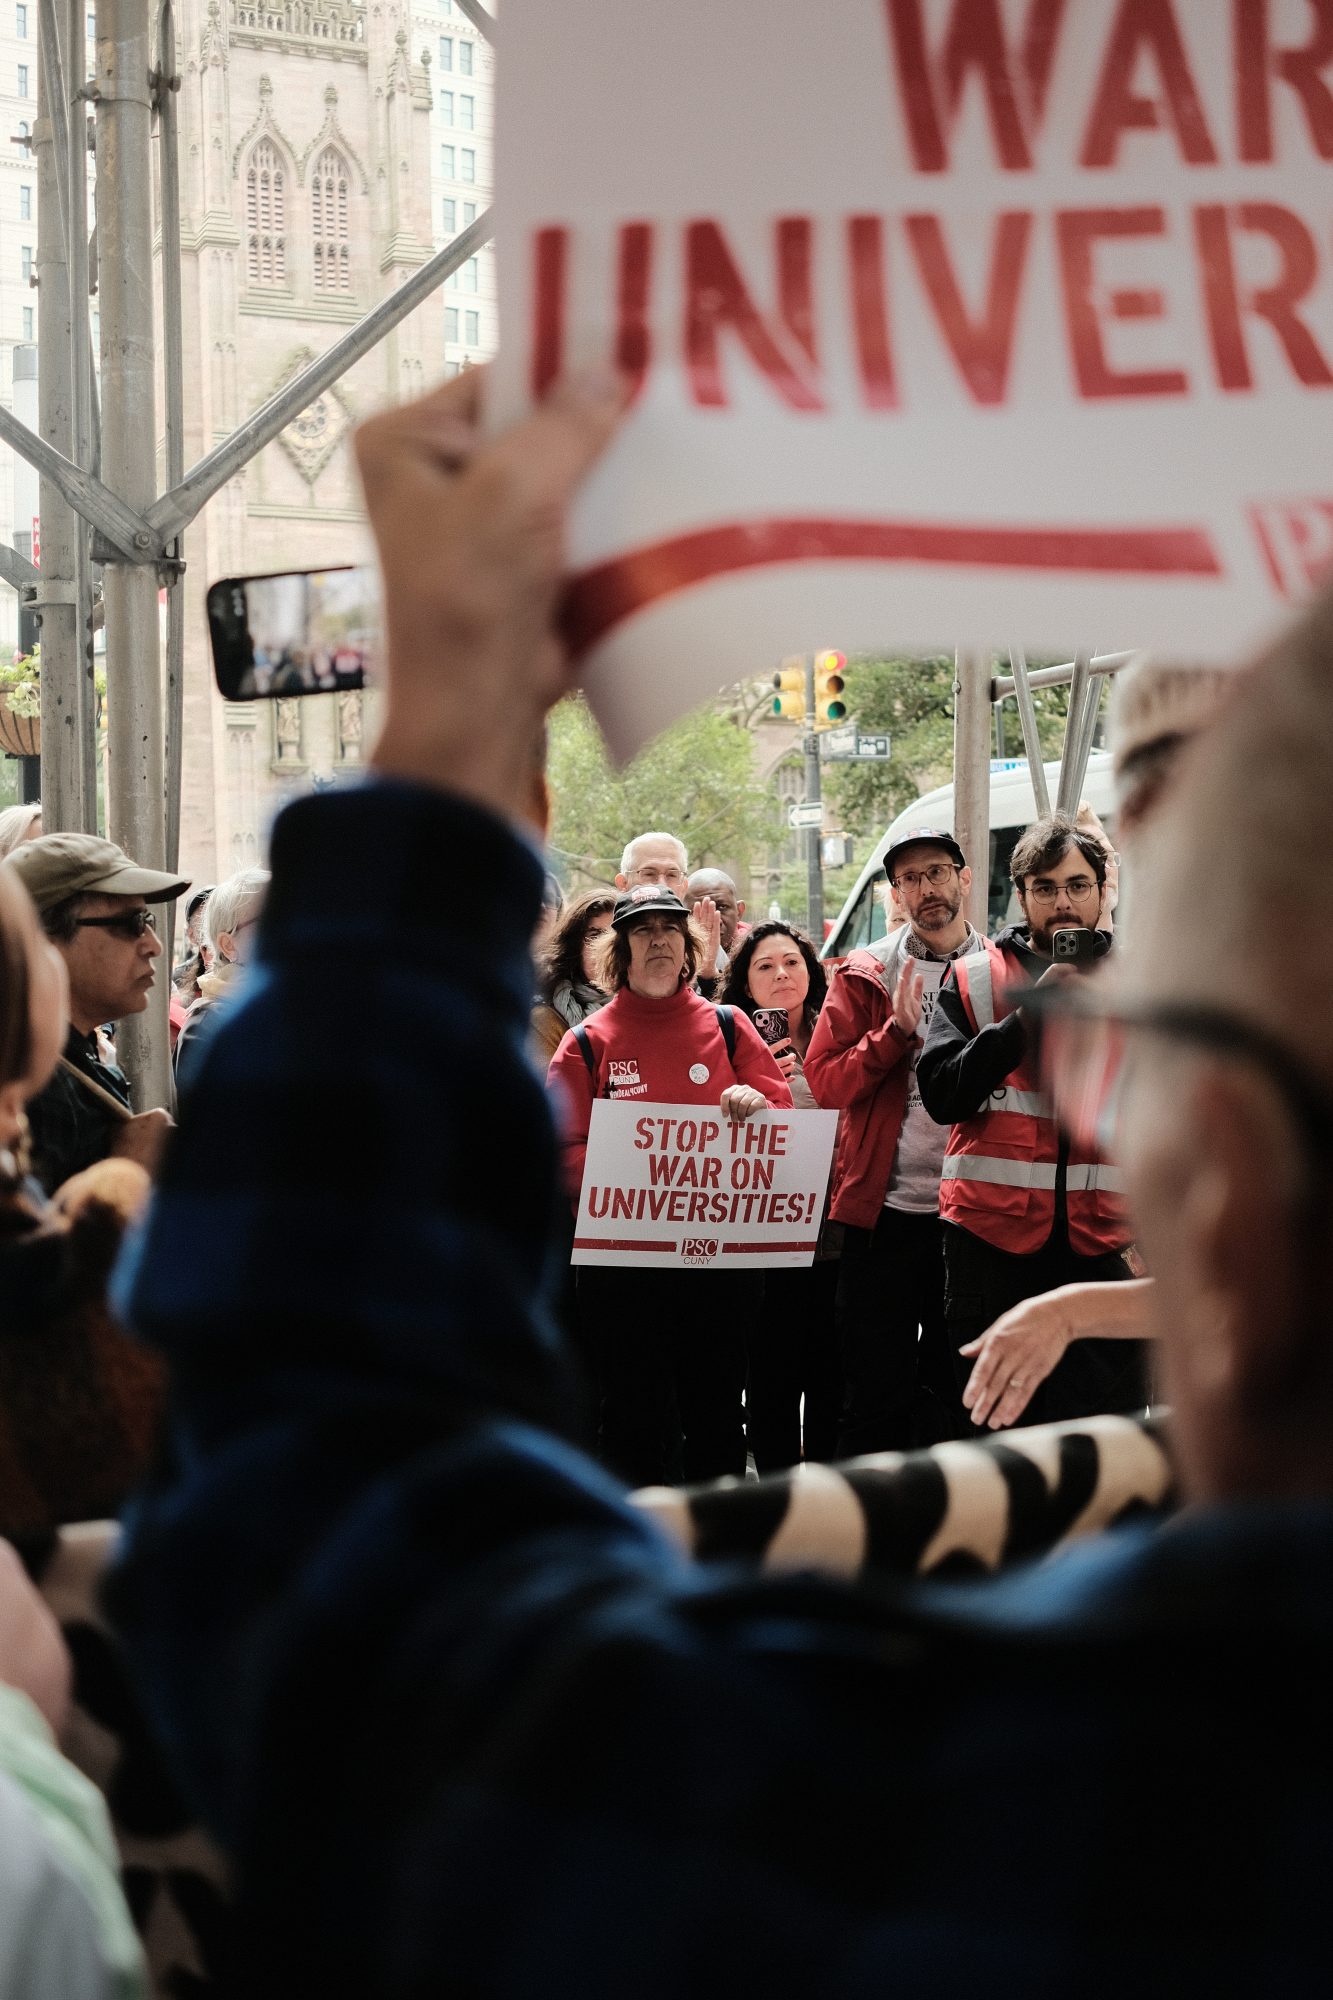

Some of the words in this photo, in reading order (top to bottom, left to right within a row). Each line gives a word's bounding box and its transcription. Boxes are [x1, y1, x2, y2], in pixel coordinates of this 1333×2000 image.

[884, 0, 1333, 175] WAR
[608, 1060, 638, 1076] PSC
[612, 1075, 636, 1084] CUNY
[634, 1117, 720, 1153] STOP
[727, 1119, 789, 1156] THE
[649, 1154, 722, 1189] WAR
[730, 1157, 775, 1190] ON
[588, 1186, 817, 1224] UNIVERSITIES!
[682, 1239, 718, 1256] PSC
[683, 1256, 712, 1265] CUNY
